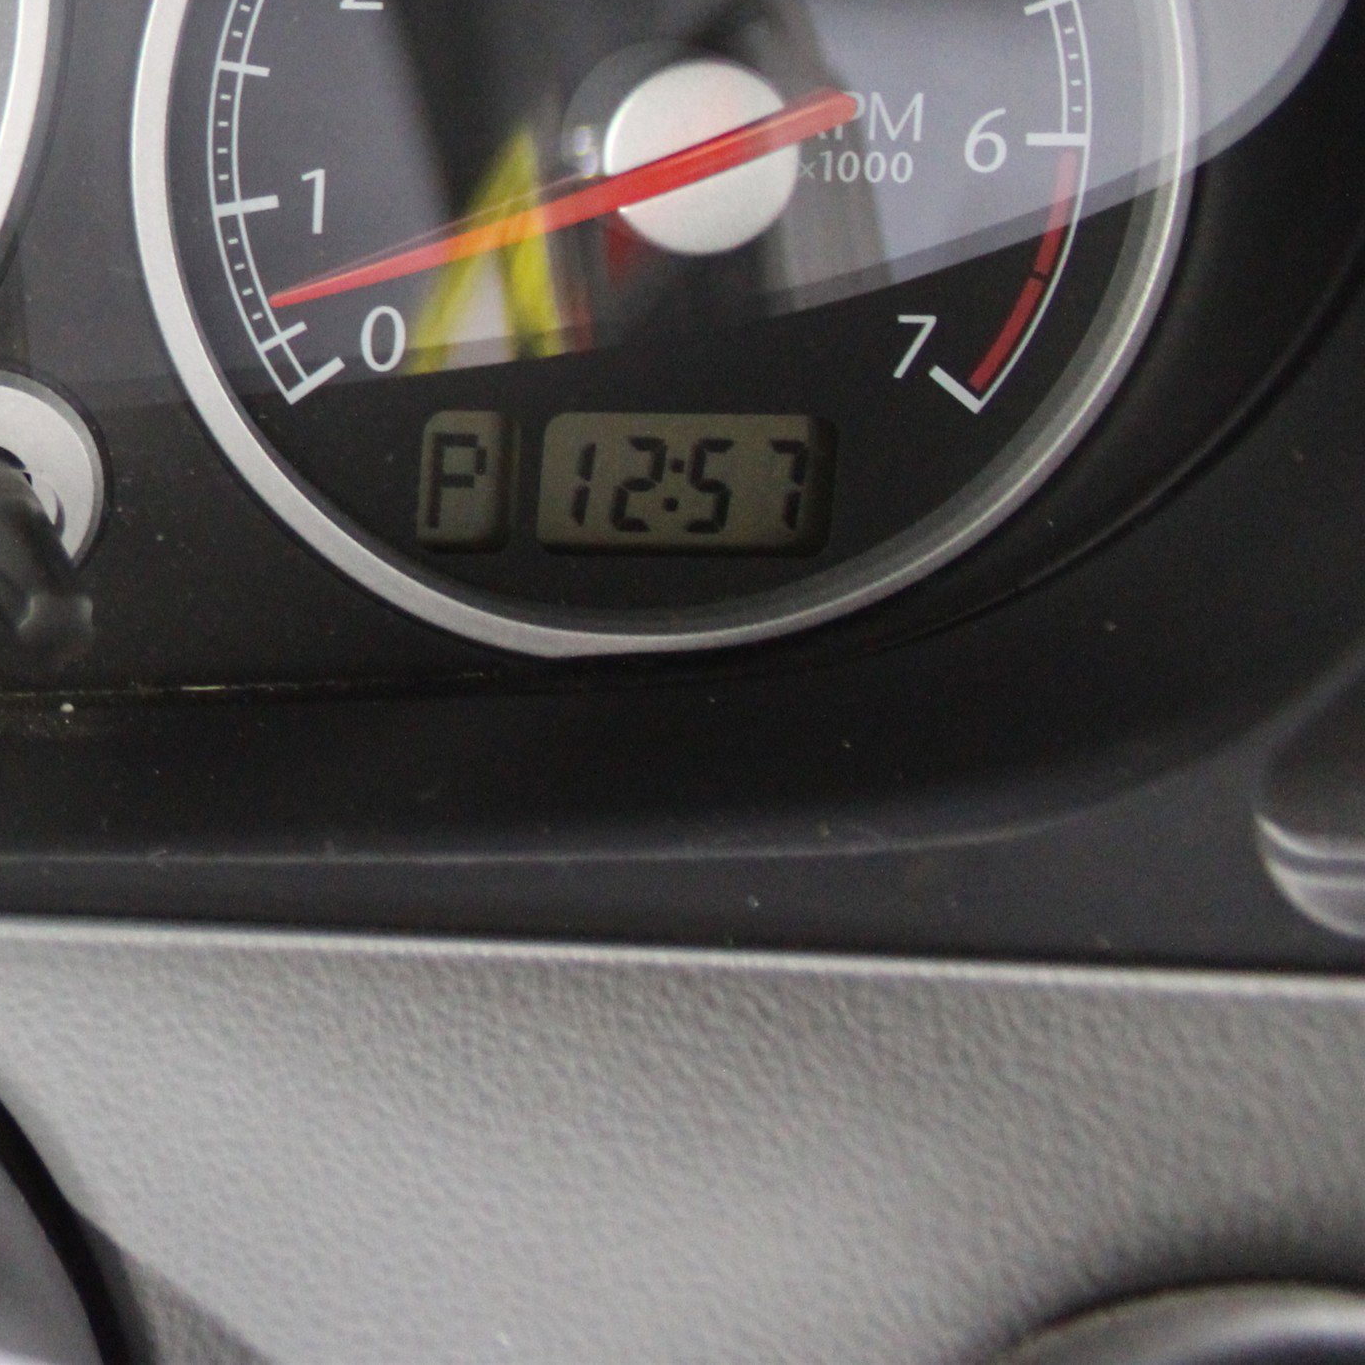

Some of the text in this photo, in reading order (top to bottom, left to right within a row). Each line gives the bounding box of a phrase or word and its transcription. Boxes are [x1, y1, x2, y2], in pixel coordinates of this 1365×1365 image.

[964, 108, 1007, 172] 6
[301, 169, 325, 234] 1
[361, 306, 406, 372] 0
[893, 315, 936, 378] 7
[426, 434, 487, 528] P
[572, 437, 807, 533] 12:57
